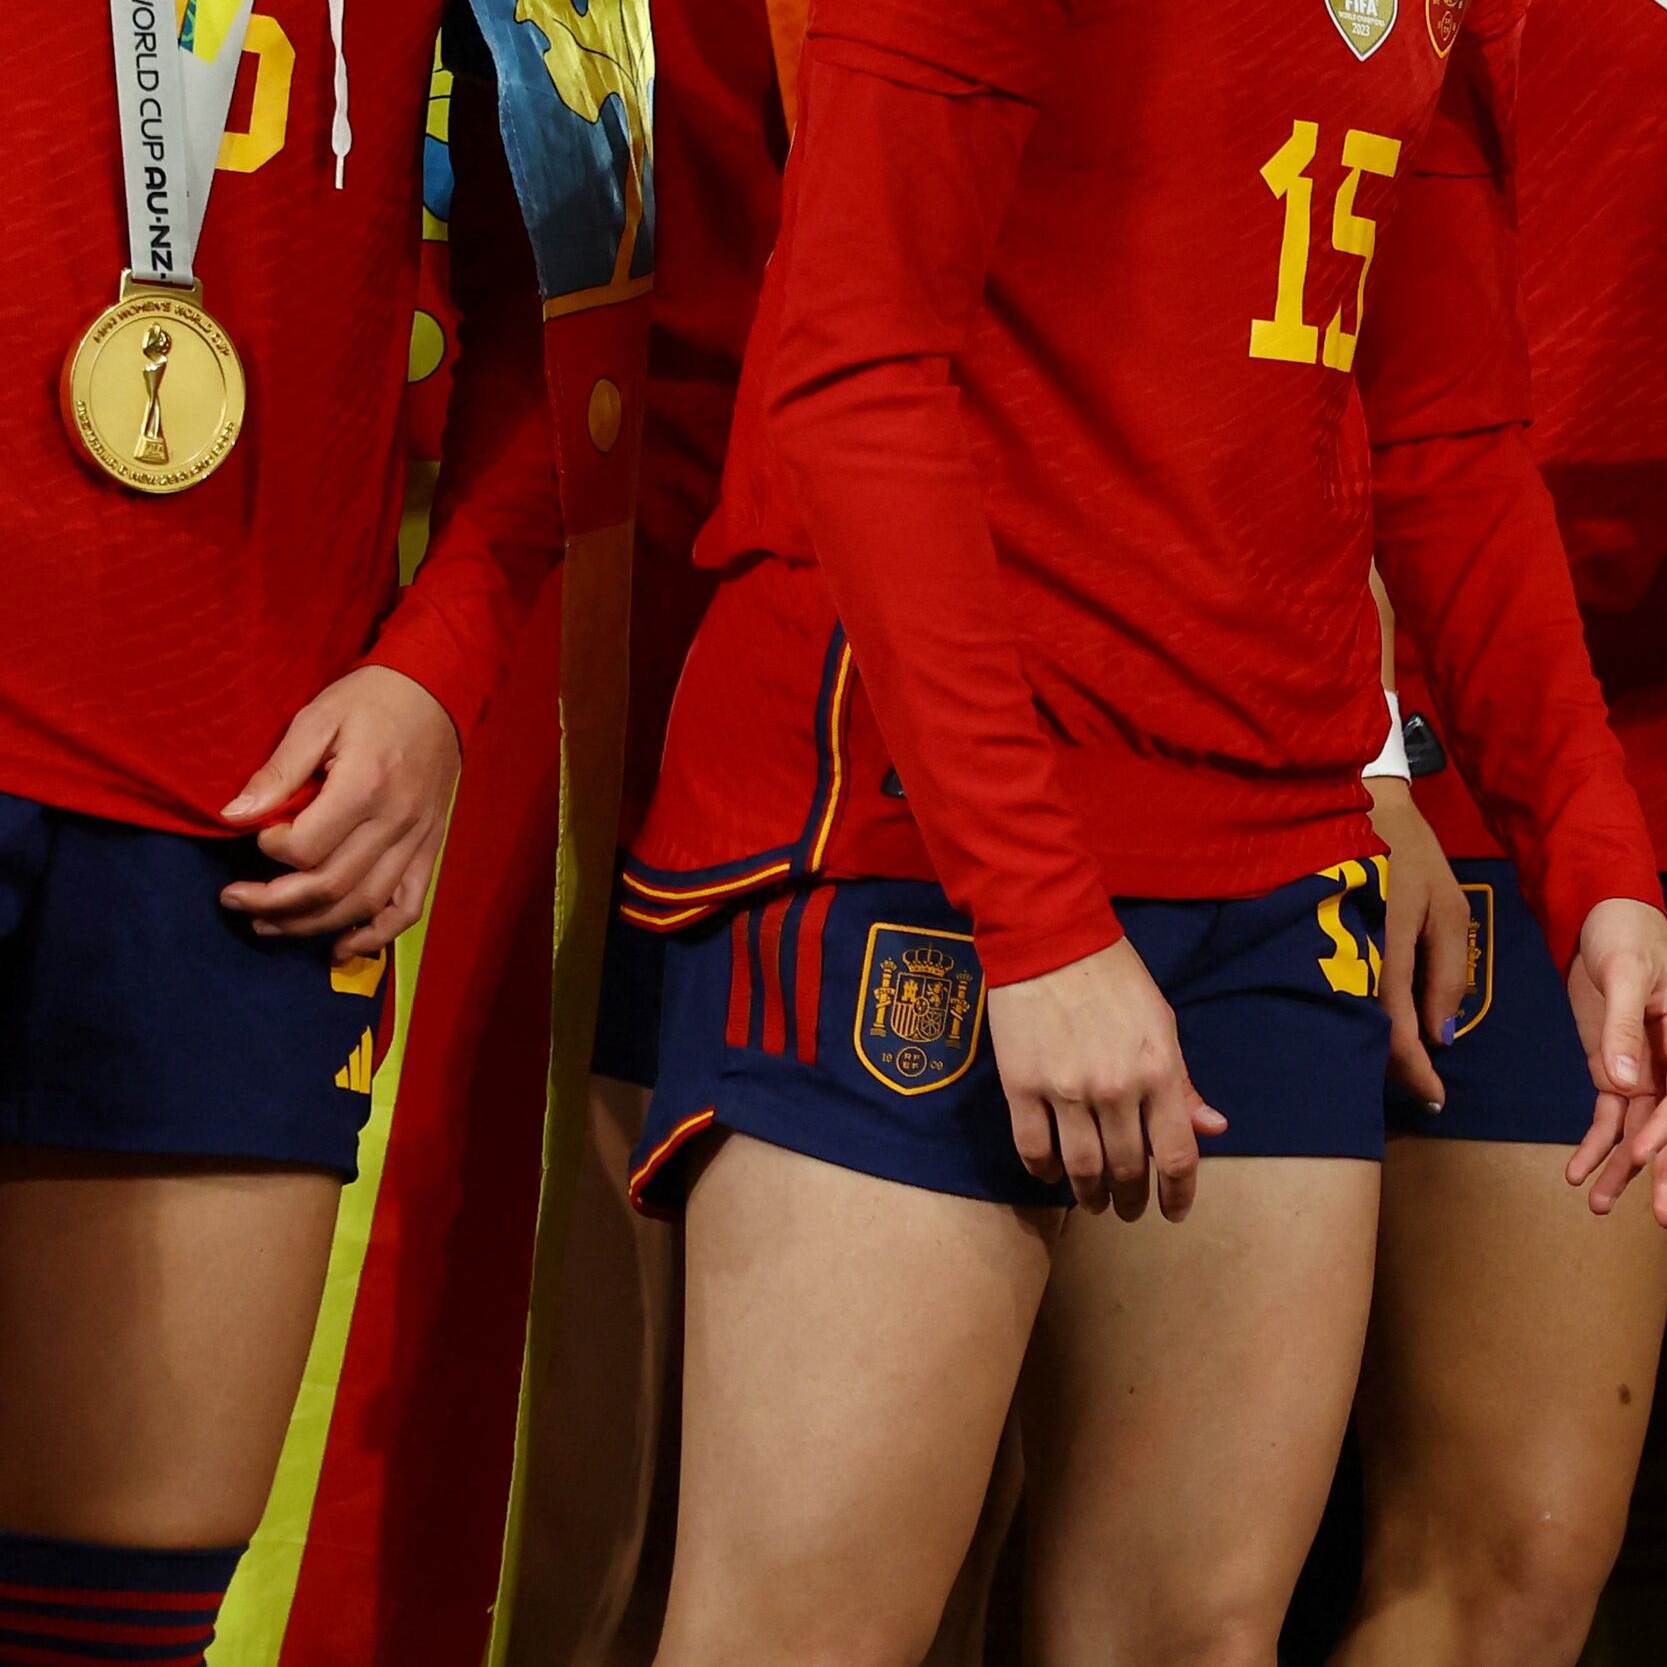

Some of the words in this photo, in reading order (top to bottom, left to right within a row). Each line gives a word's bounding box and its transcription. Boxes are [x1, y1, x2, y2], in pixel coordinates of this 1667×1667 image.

[1351, 22, 1371, 37] 2023
[139, 97, 165, 162] CUP
[1249, 119, 1402, 373] 15
